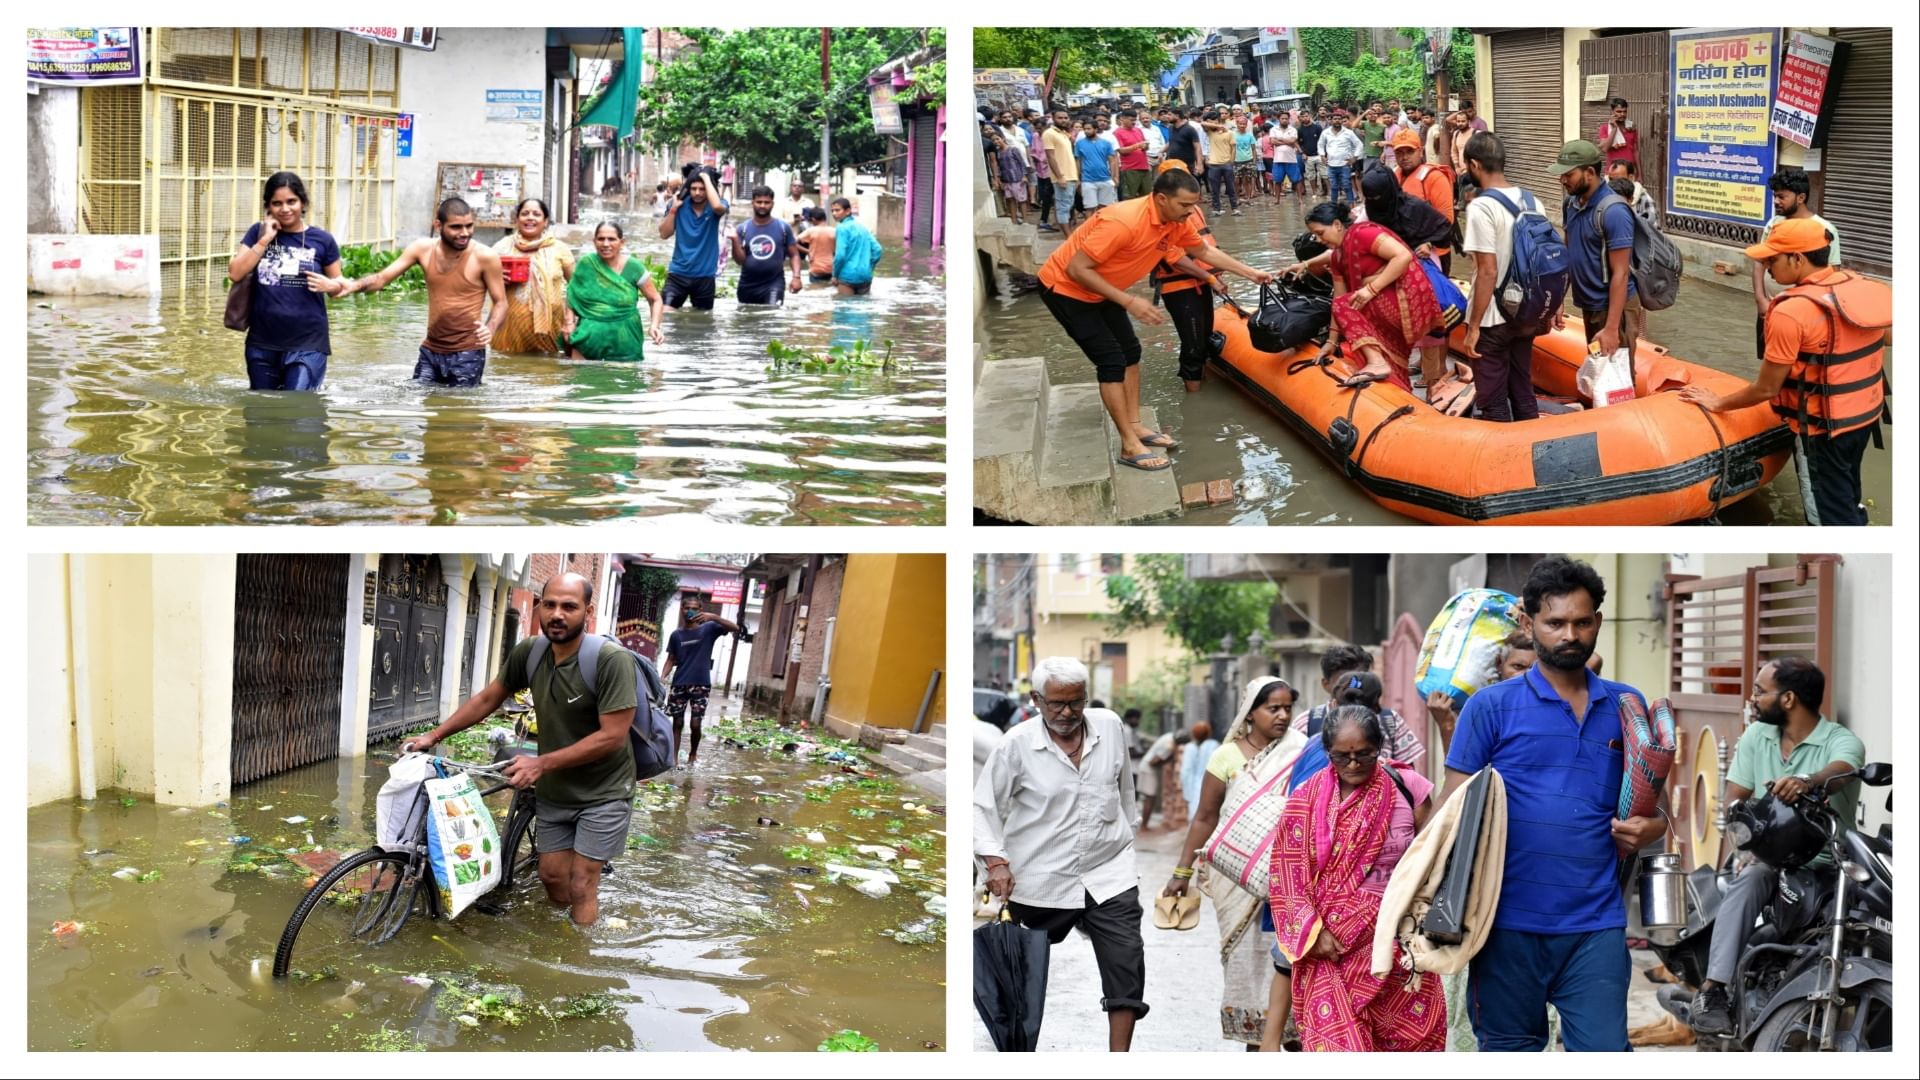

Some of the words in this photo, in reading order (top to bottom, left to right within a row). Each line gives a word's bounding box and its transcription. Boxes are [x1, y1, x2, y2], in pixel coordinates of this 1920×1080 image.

[58, 40, 89, 49] Special
[1694, 38, 1751, 62] कनक
[1678, 64, 1728, 80] नर्सिंग
[1732, 62, 1768, 78] होम
[1677, 94, 1687, 107] Dr.
[1688, 94, 1718, 107] Manish
[1719, 93, 1767, 107] Kushwaha
[1679, 111, 1704, 120] (MBBS)
[1773, 107, 1789, 126] कनक
[1787, 110, 1804, 133] नर्सिंग
[1802, 115, 1815, 137] होम
